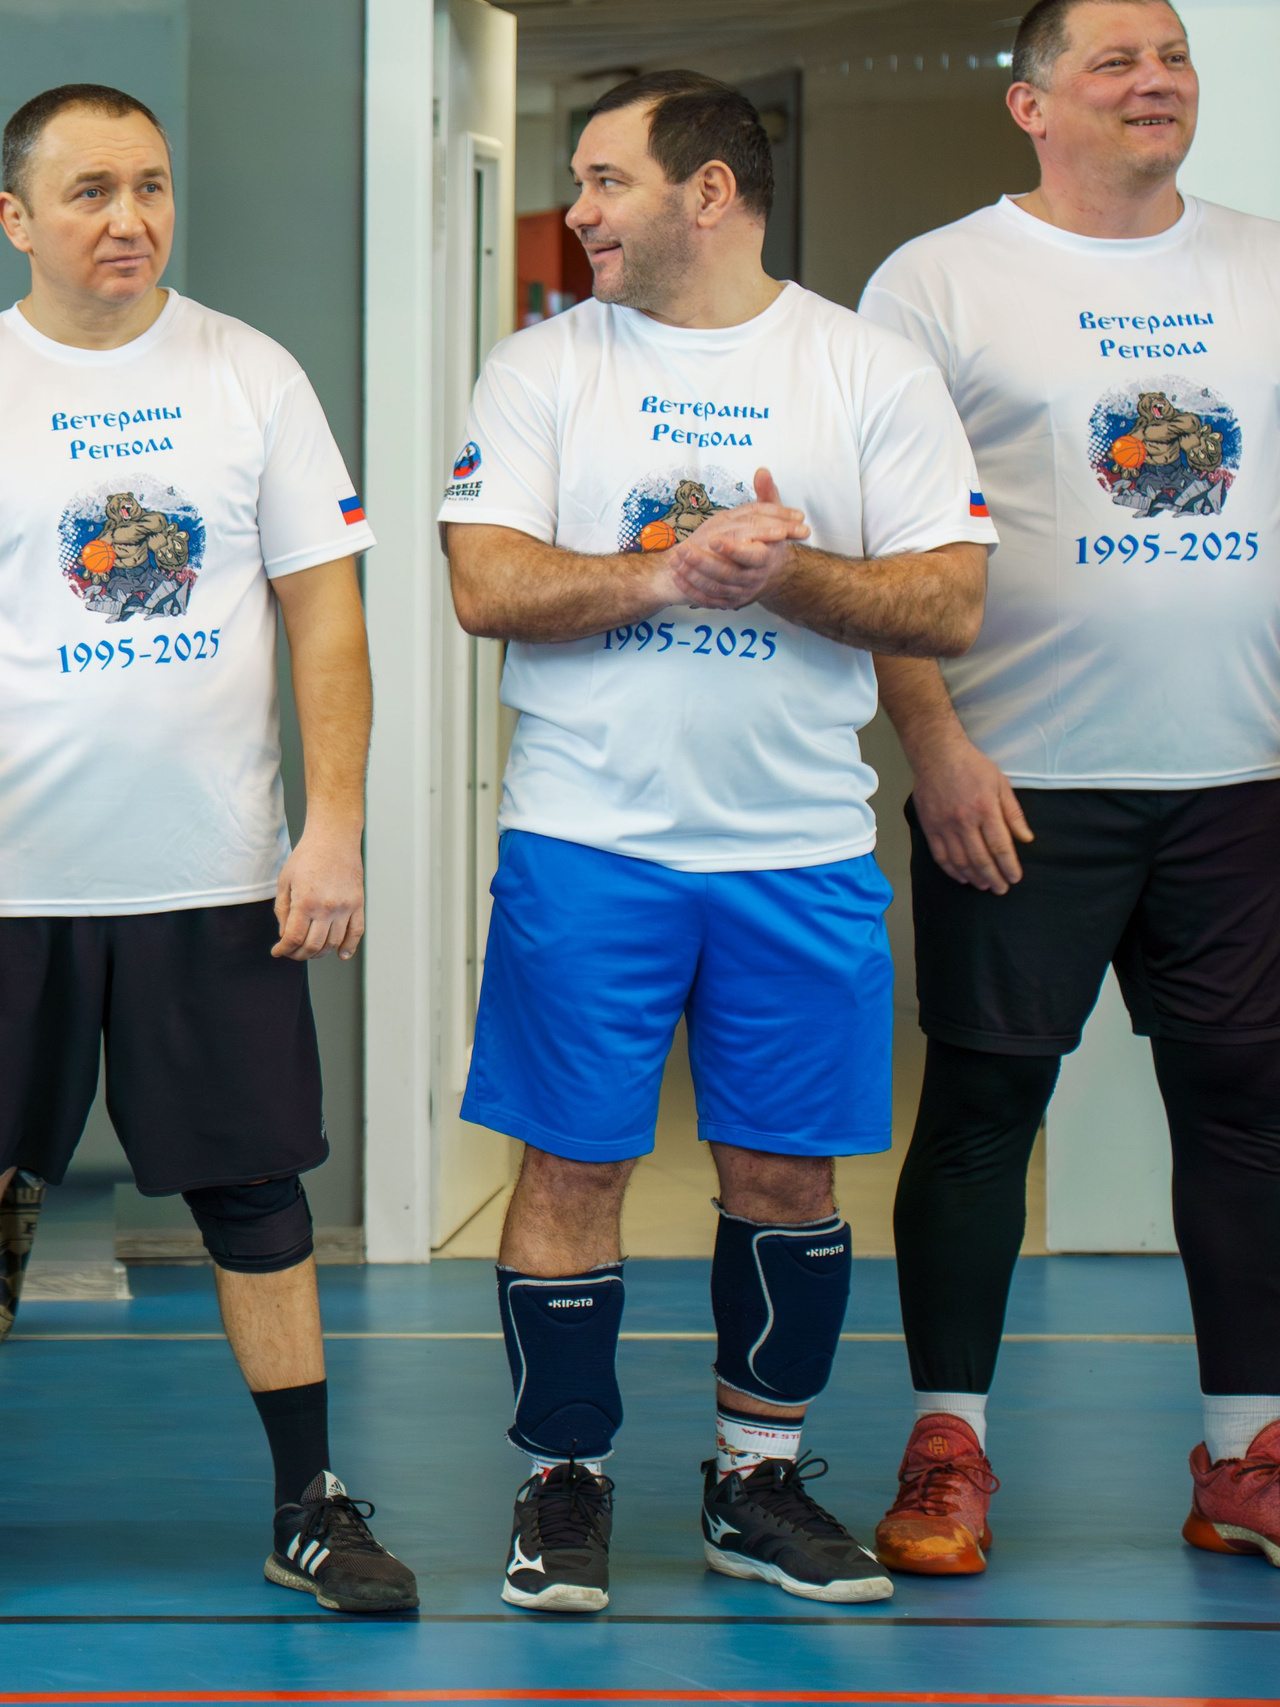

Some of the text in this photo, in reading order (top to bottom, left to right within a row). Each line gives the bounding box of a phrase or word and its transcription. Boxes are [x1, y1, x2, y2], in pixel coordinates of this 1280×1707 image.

[1079, 311, 1215, 335] Ветераны
[1099, 339, 1208, 359] Регбола
[51, 406, 183, 432] Ветераны
[640, 395, 770, 422] Ветераны
[70, 436, 174, 460] Регбола
[651, 423, 754, 449] Регбола
[1075, 531, 1259, 566] 1995-2025
[57, 628, 222, 675] 1995-2025
[602, 620, 779, 662] 1995-2025
